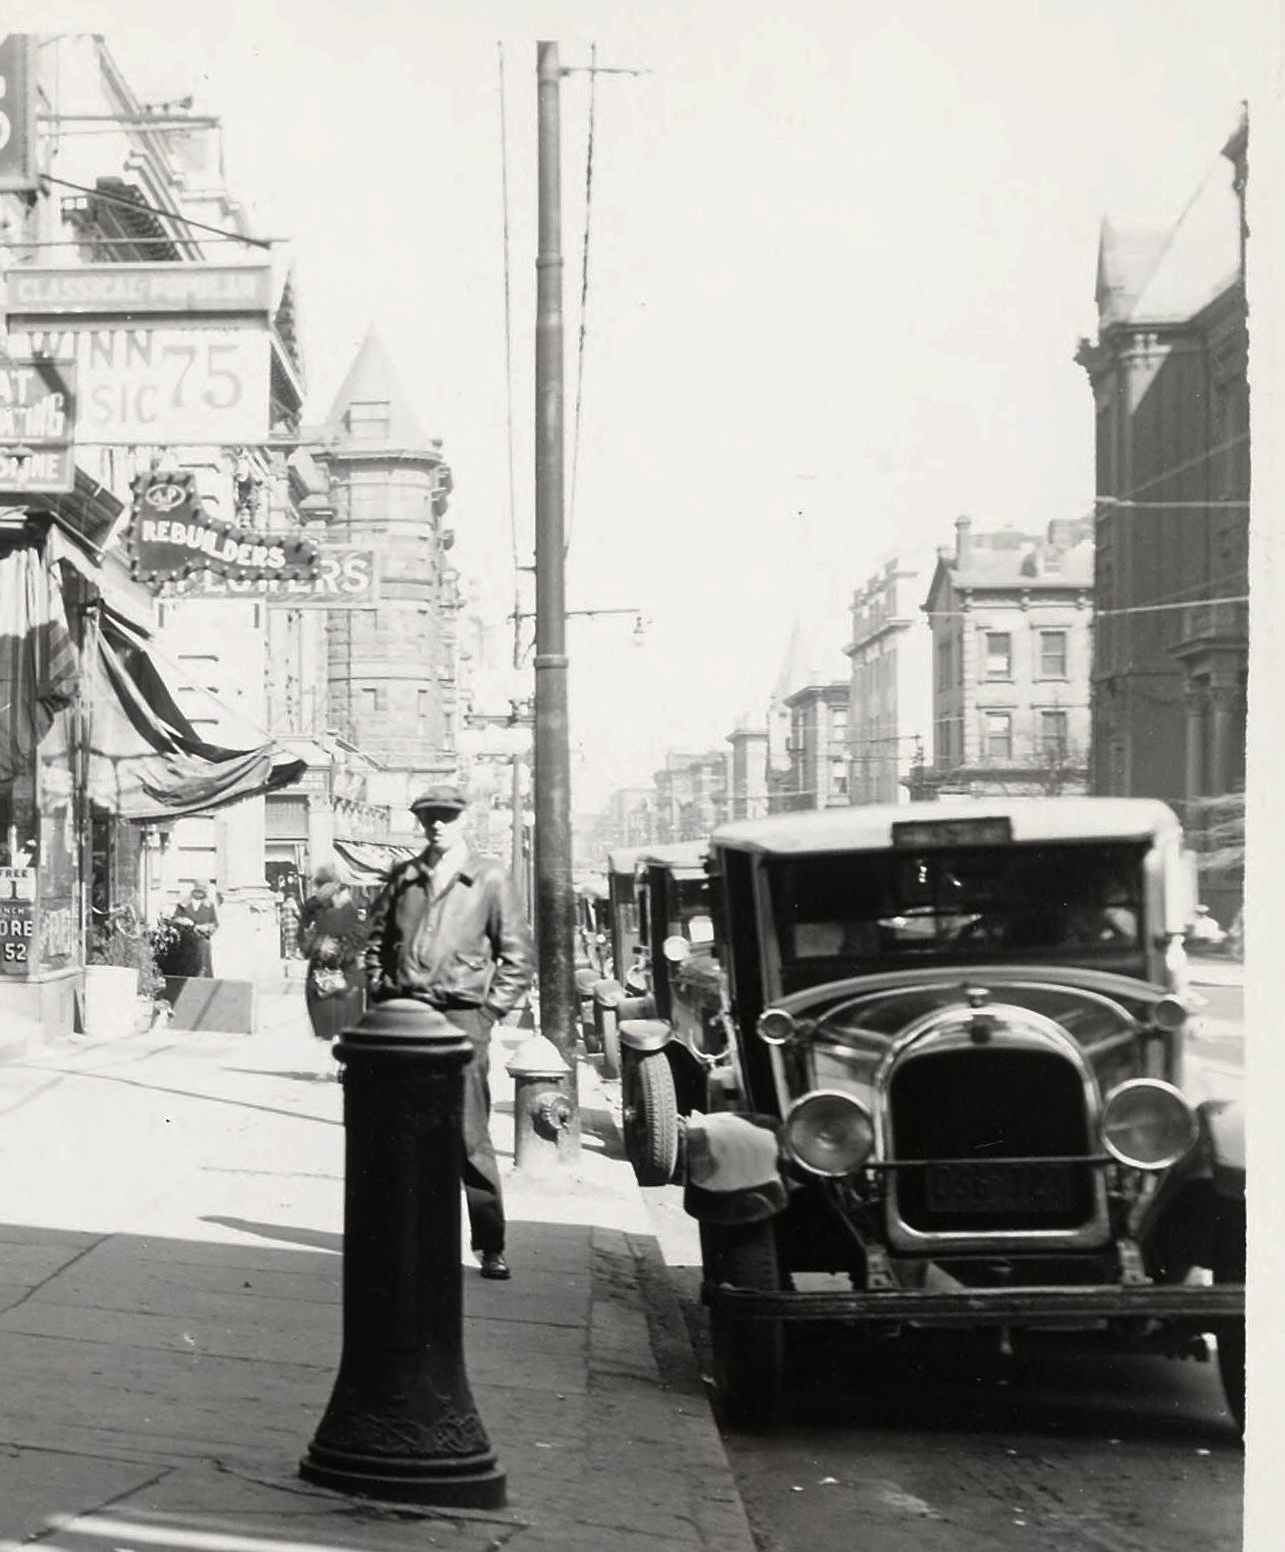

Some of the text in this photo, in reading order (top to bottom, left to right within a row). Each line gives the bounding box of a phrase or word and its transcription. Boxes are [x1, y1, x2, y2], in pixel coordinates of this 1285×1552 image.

[161, 345, 243, 409] 75
[141, 520, 287, 568] REBUILDERS
[4, 942, 27, 961] 52
